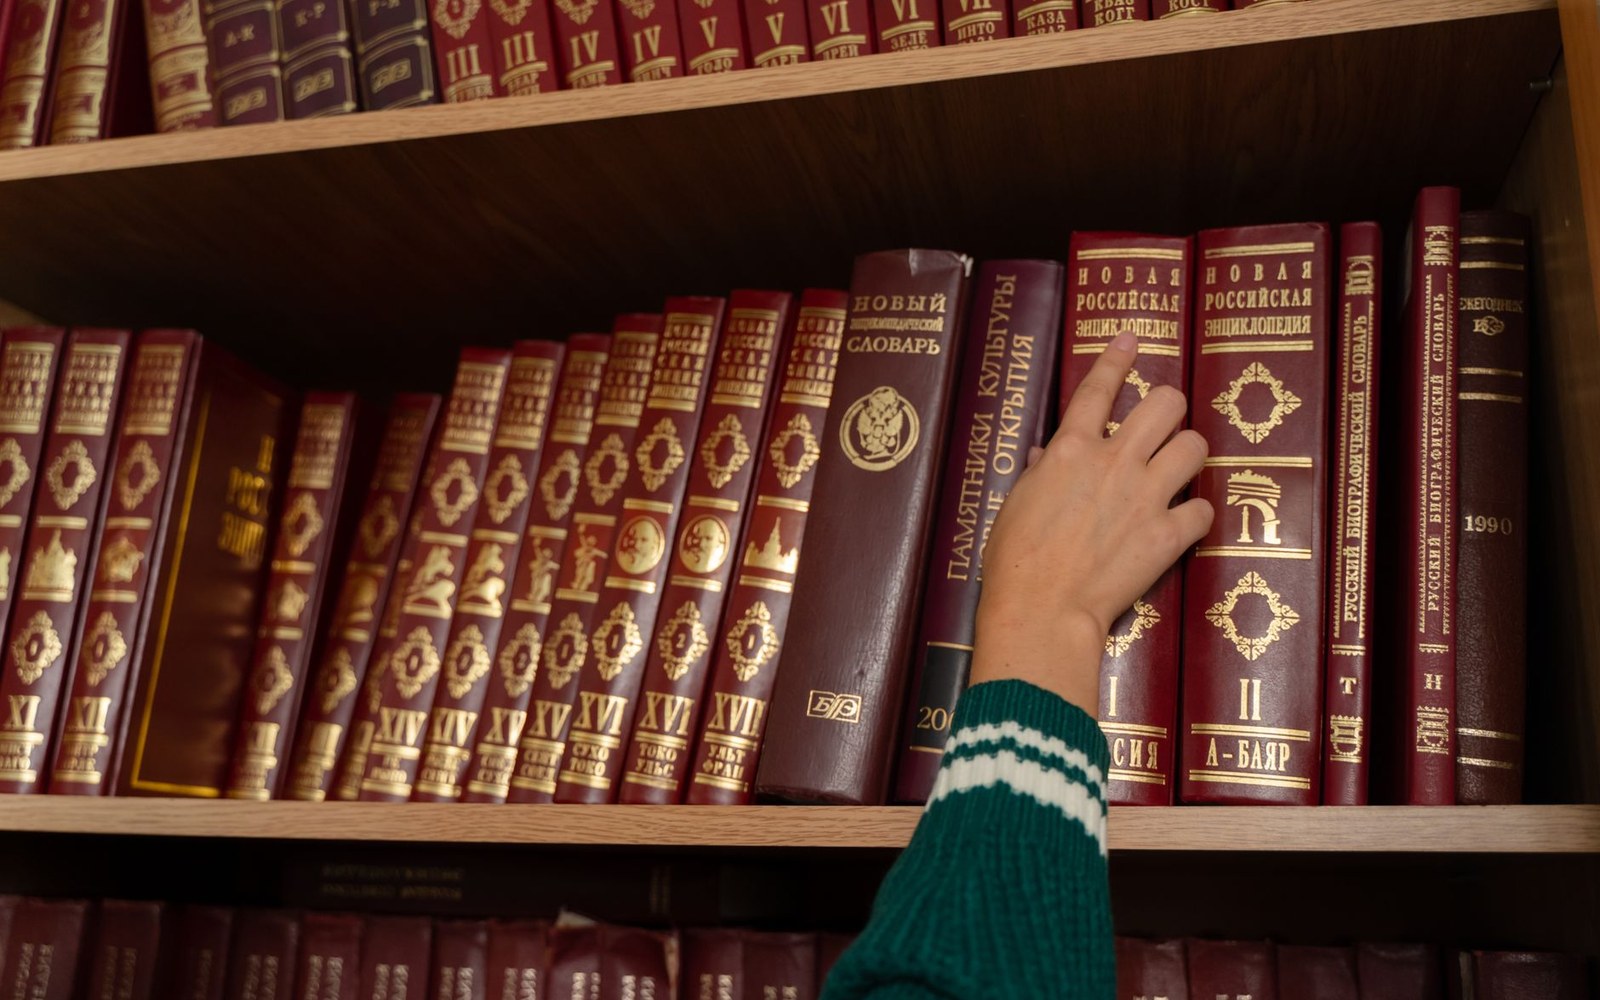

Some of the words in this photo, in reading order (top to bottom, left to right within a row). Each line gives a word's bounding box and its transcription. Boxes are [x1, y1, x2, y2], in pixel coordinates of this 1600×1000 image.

[699, 16, 718, 48] V
[765, 12, 784, 45] V
[820, 1, 852, 35] VI
[1026, 11, 1067, 31] КАЗА
[446, 44, 480, 83] III
[503, 31, 538, 71] III
[570, 30, 600, 69] IV
[633, 25, 662, 64] IV
[1078, 266, 1181, 287] НОВАЯ
[1206, 260, 1313, 285] НОВАЯ
[852, 293, 947, 313] НОВЫЙ
[1076, 289, 1180, 313] РОССИЙСКАЯ
[1205, 287, 1313, 311] РОССИЙСКАЯ
[847, 336, 942, 356] СЛОВАРЬ
[1205, 315, 1312, 338] ЭНЦИКЛОПЕДИЯ
[1432, 292, 1445, 362] СЛОВАРЬ
[1351, 315, 1367, 384] СЛОВАРЬ
[993, 333, 1035, 476] ОТКРЫТИЯ
[948, 412, 994, 581] ПАМЯТНИКИ
[977, 273, 1016, 398] КУЛЬТУРЫ
[1346, 391, 1365, 539] БИОГРАФИЧЕСКИЙ
[1429, 374, 1445, 524] БИОГРАФИЧЕСКИЙ
[1464, 514, 1513, 536] 1990
[1343, 545, 1361, 622] РУССКИЙ
[1427, 535, 1442, 612] РУССКИЙ
[1108, 676, 1118, 717] I
[1239, 678, 1262, 721] II
[1339, 676, 1357, 695] Т
[1424, 673, 1443, 690] Н
[3, 695, 42, 731] XI
[374, 706, 428, 747] XIV
[483, 706, 528, 747] XV
[527, 700, 573, 740] XV
[573, 690, 629, 736] XVI
[638, 690, 695, 736] XVI
[707, 691, 767, 737] XVII
[917, 706, 956, 731] 20
[1113, 737, 1159, 770] СИЯ
